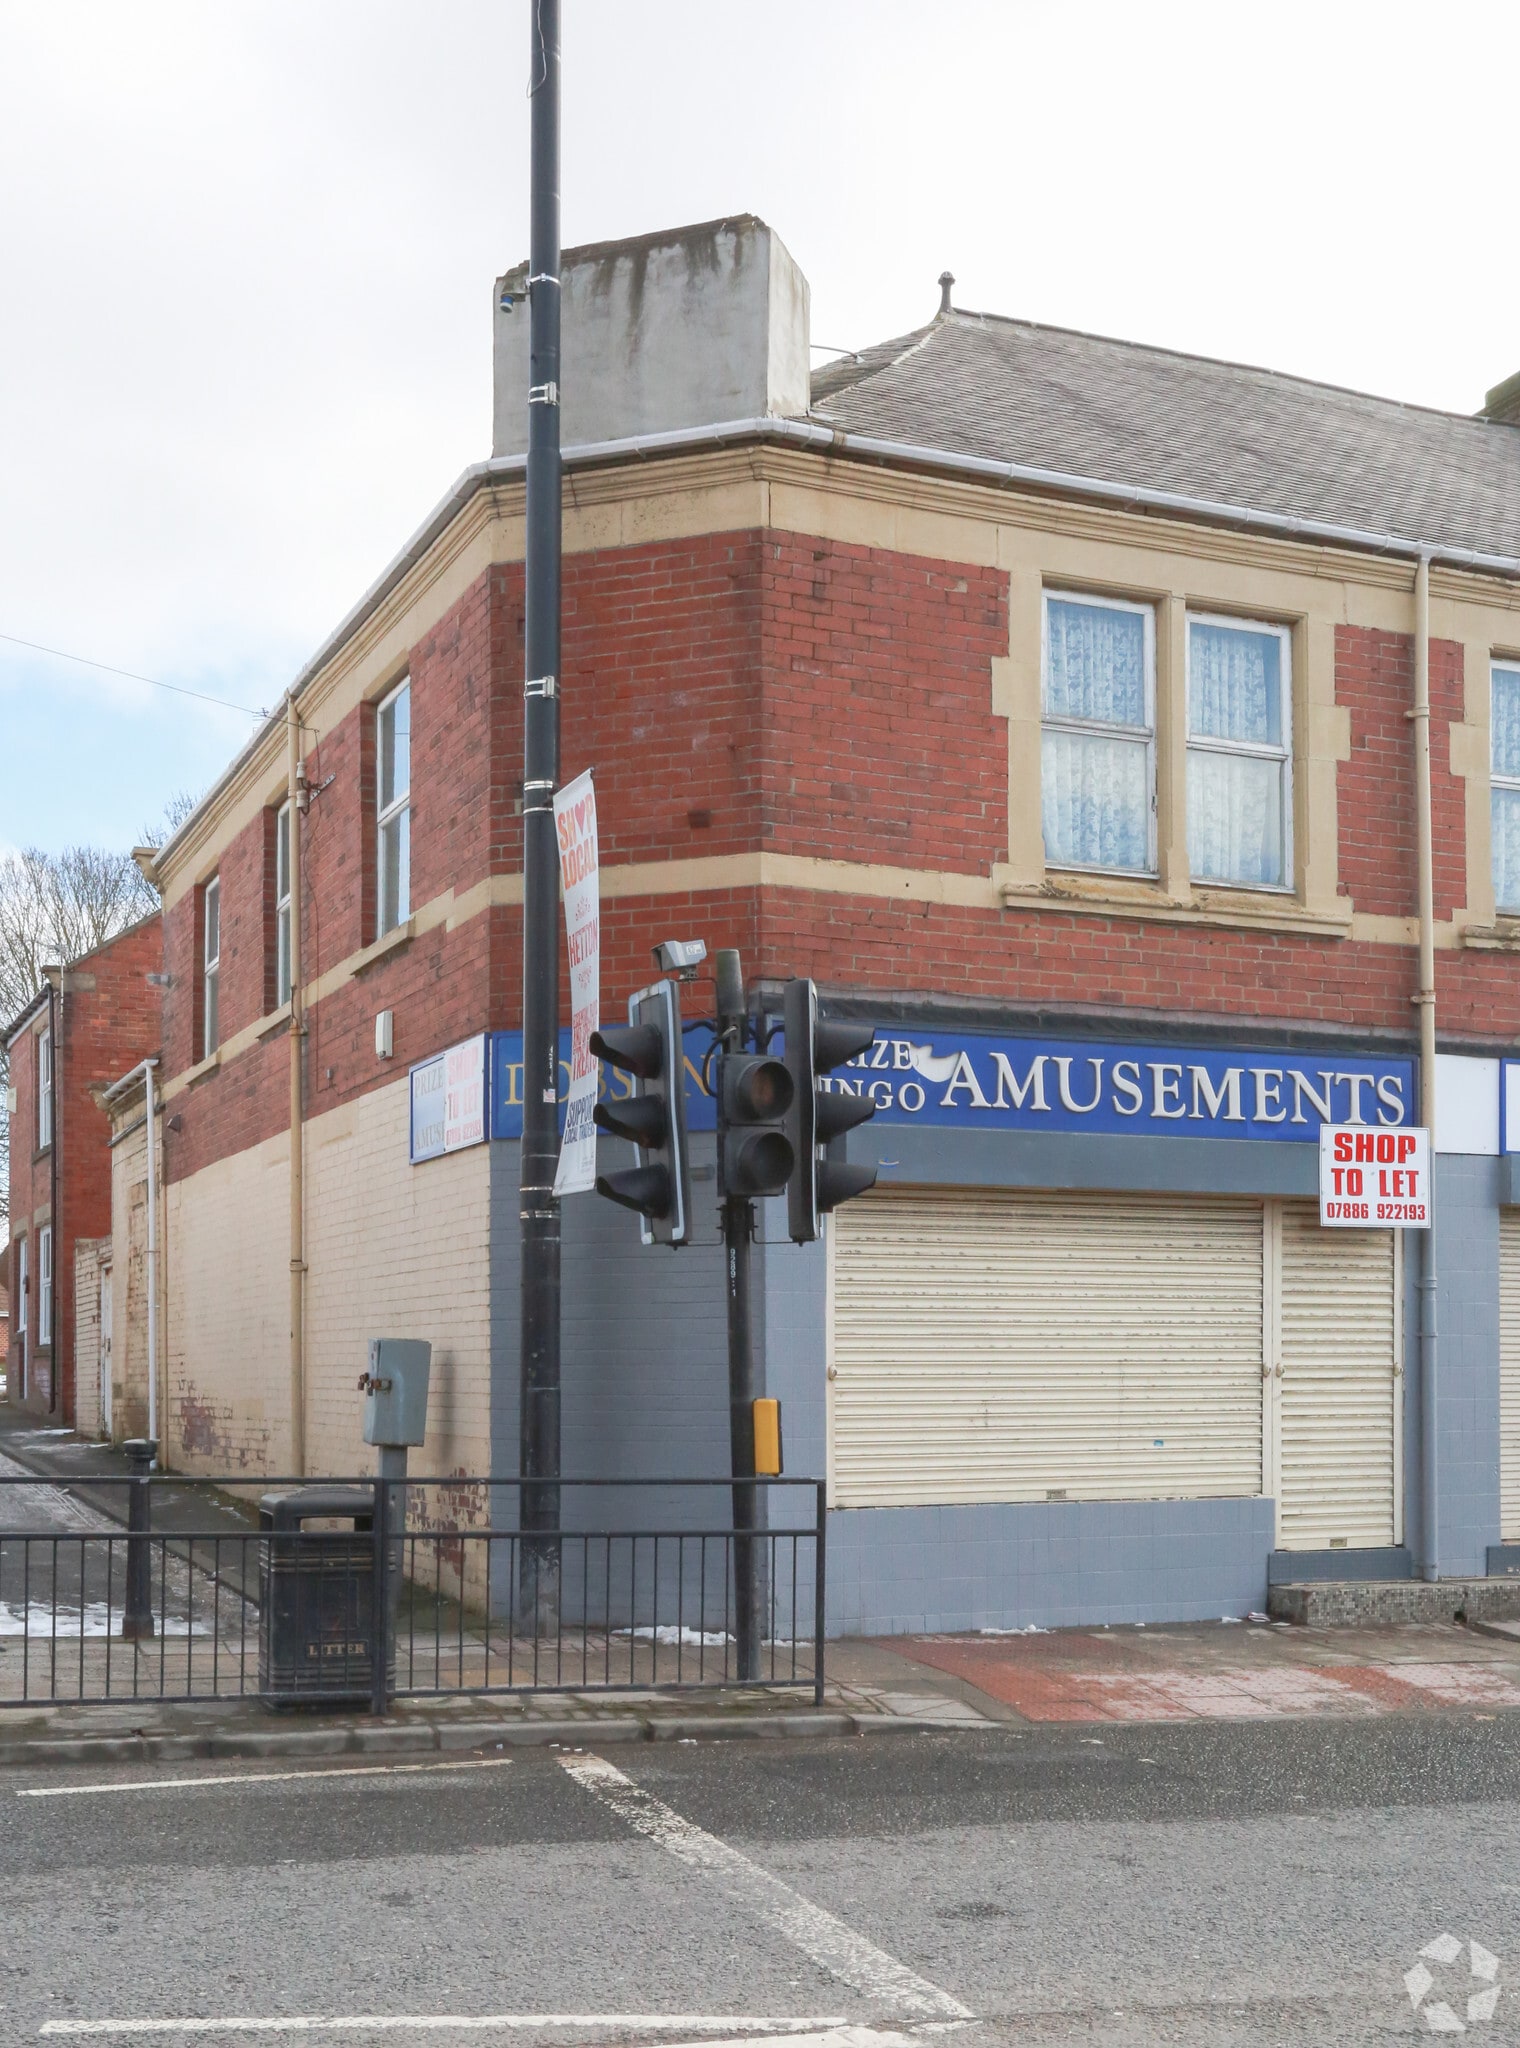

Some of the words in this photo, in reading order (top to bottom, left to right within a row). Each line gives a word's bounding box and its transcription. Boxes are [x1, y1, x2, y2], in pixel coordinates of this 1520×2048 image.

[562, 835, 597, 890] LOCAL
[569, 917, 598, 968] HETTON
[414, 1066, 444, 1098] PRIZE
[448, 1046, 479, 1086] SHOP
[448, 1091, 460, 1121] TO
[464, 1082, 481, 1116] LET
[939, 1050, 1405, 1126] AMUSEMENTS
[1334, 1132, 1416, 1164] SHOP
[1331, 1168, 1363, 1197] TO
[1378, 1169, 1419, 1198] LET
[1326, 1202, 1369, 1219] 07886
[1376, 1203, 1426, 1220] 922193
